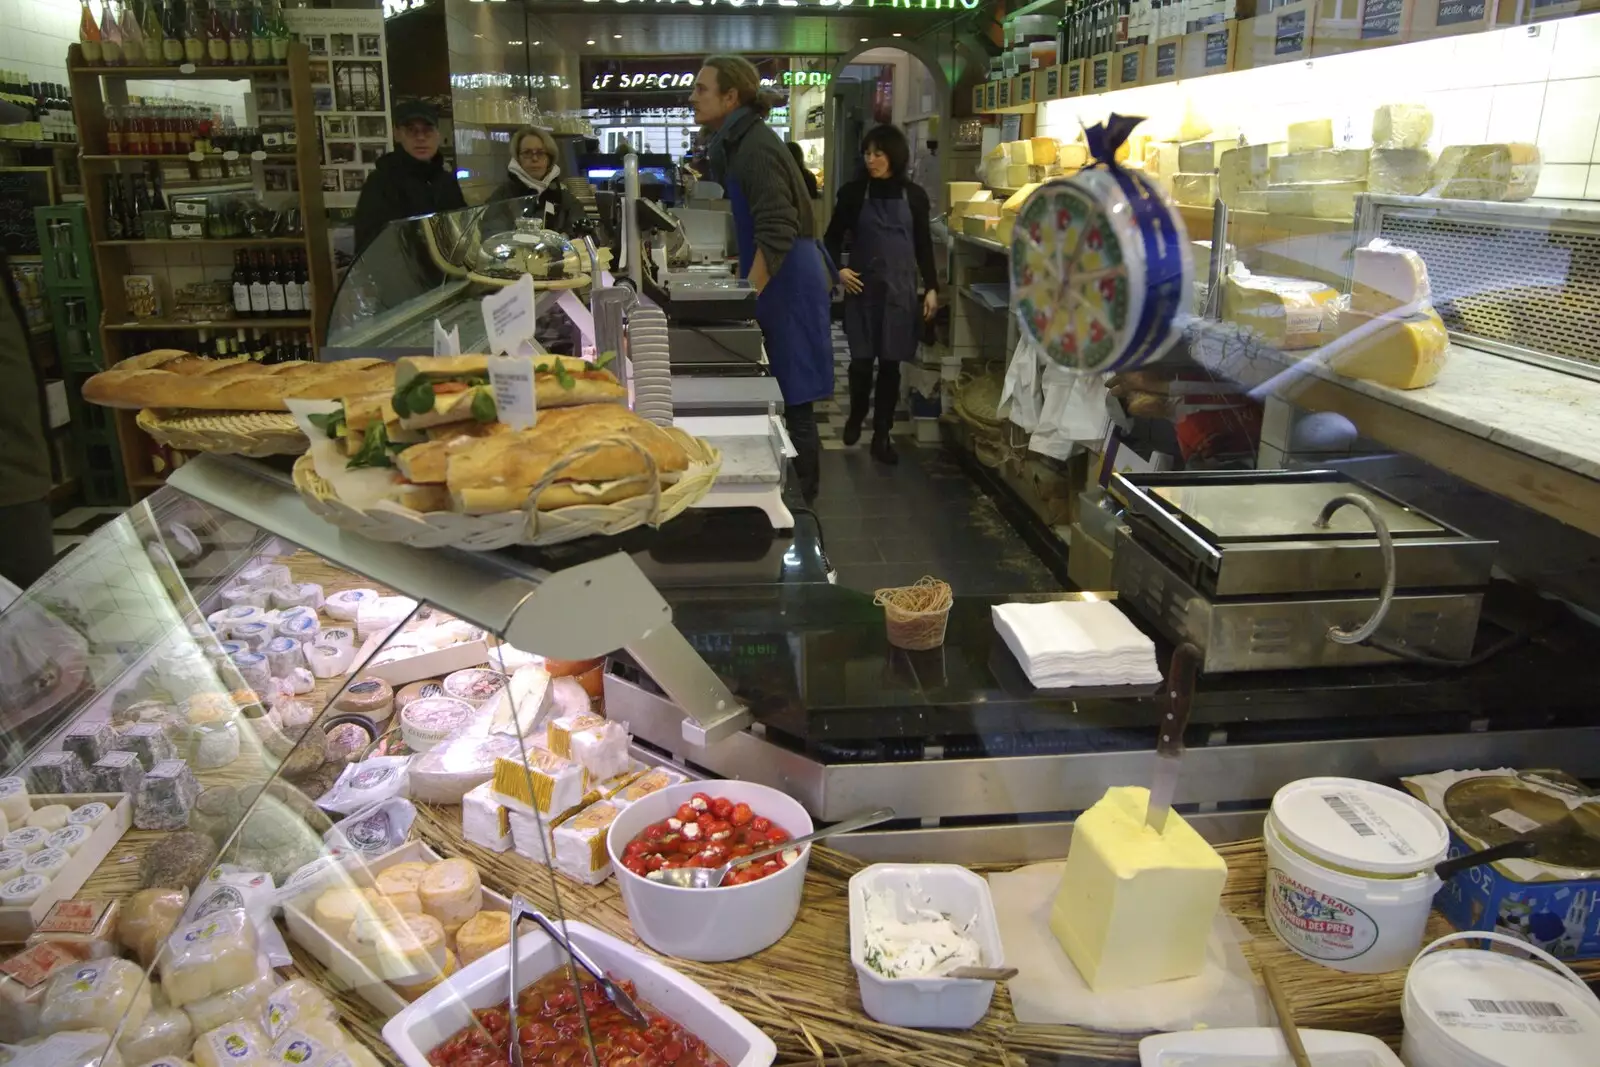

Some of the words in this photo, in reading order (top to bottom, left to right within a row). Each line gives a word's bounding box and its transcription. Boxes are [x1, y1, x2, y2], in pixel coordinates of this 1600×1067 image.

[619, 73, 695, 88] SPECIA
[1275, 871, 1318, 897] FROMAGE
[1321, 893, 1356, 916] FRAIS
[1308, 920, 1325, 931] DES
